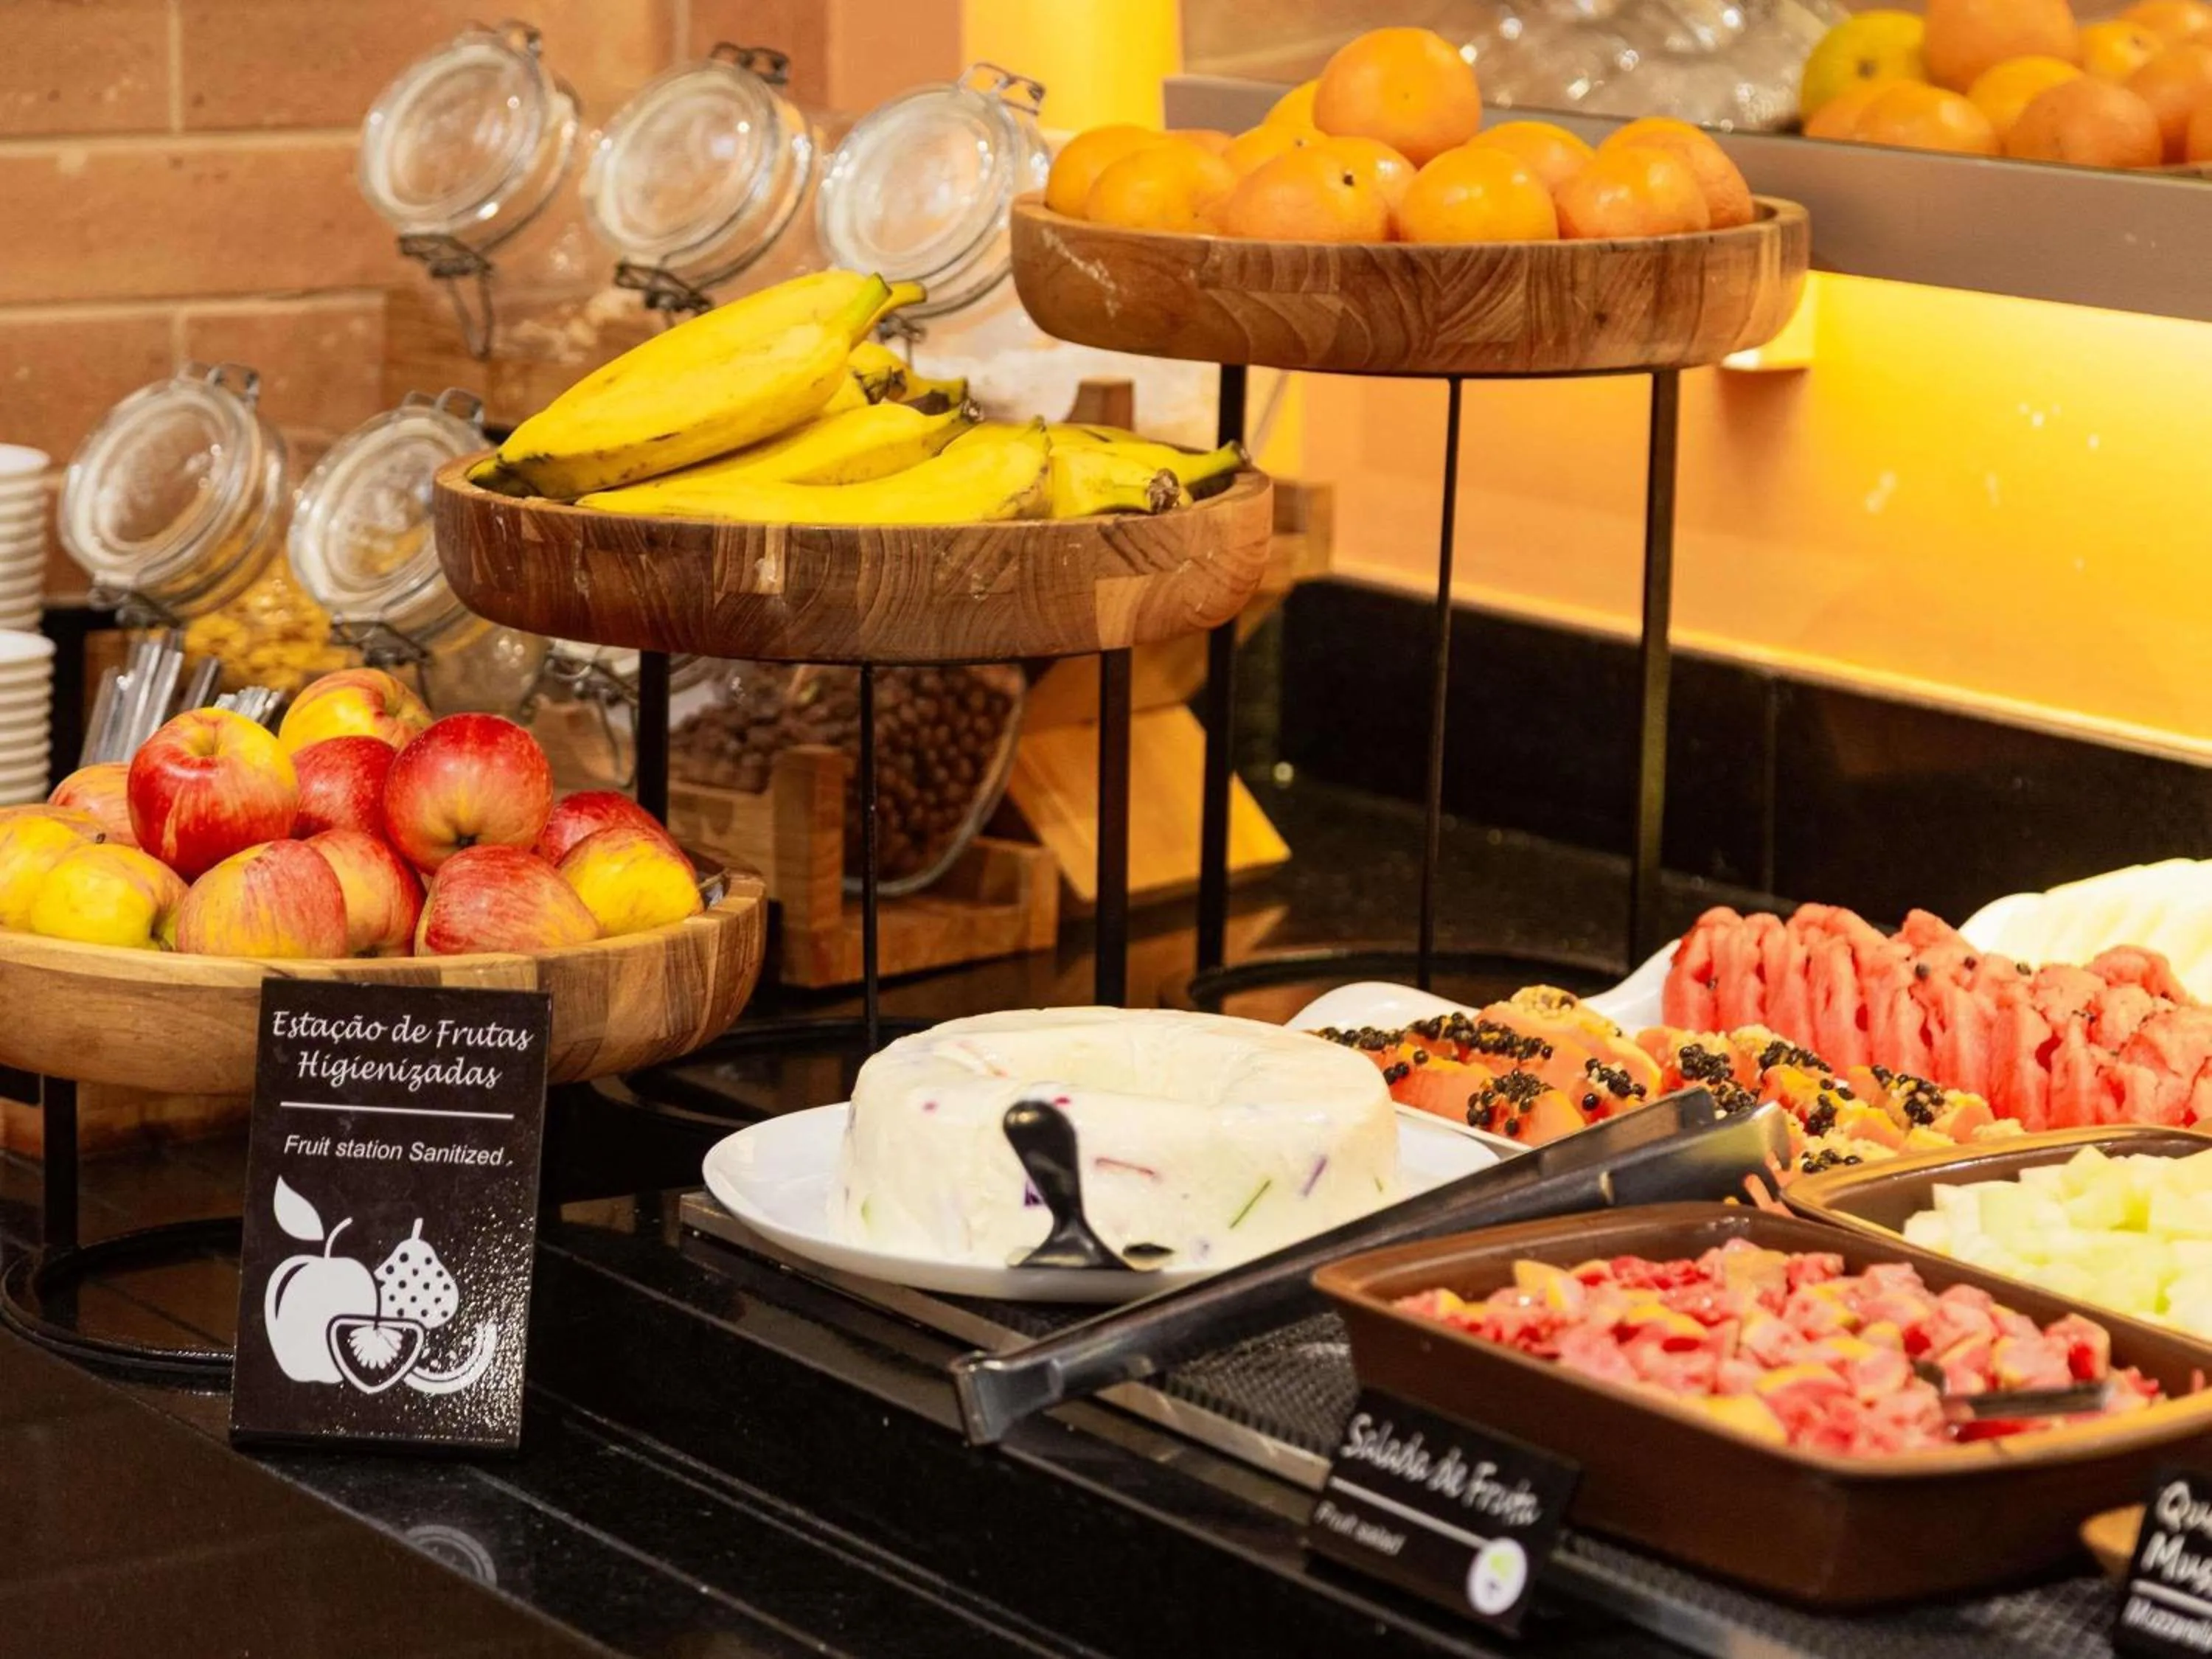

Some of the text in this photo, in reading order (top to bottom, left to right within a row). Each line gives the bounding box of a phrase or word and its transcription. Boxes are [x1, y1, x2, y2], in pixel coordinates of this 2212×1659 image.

[273, 1011, 534, 1051] Estação de Frutas
[298, 1050, 503, 1092] Higienizadas
[284, 1135, 504, 1166] Fruit station Sanitized
[1340, 1413, 1431, 1482] Salada
[1426, 1447, 1468, 1498] de
[1314, 1500, 1358, 1535] Fruit
